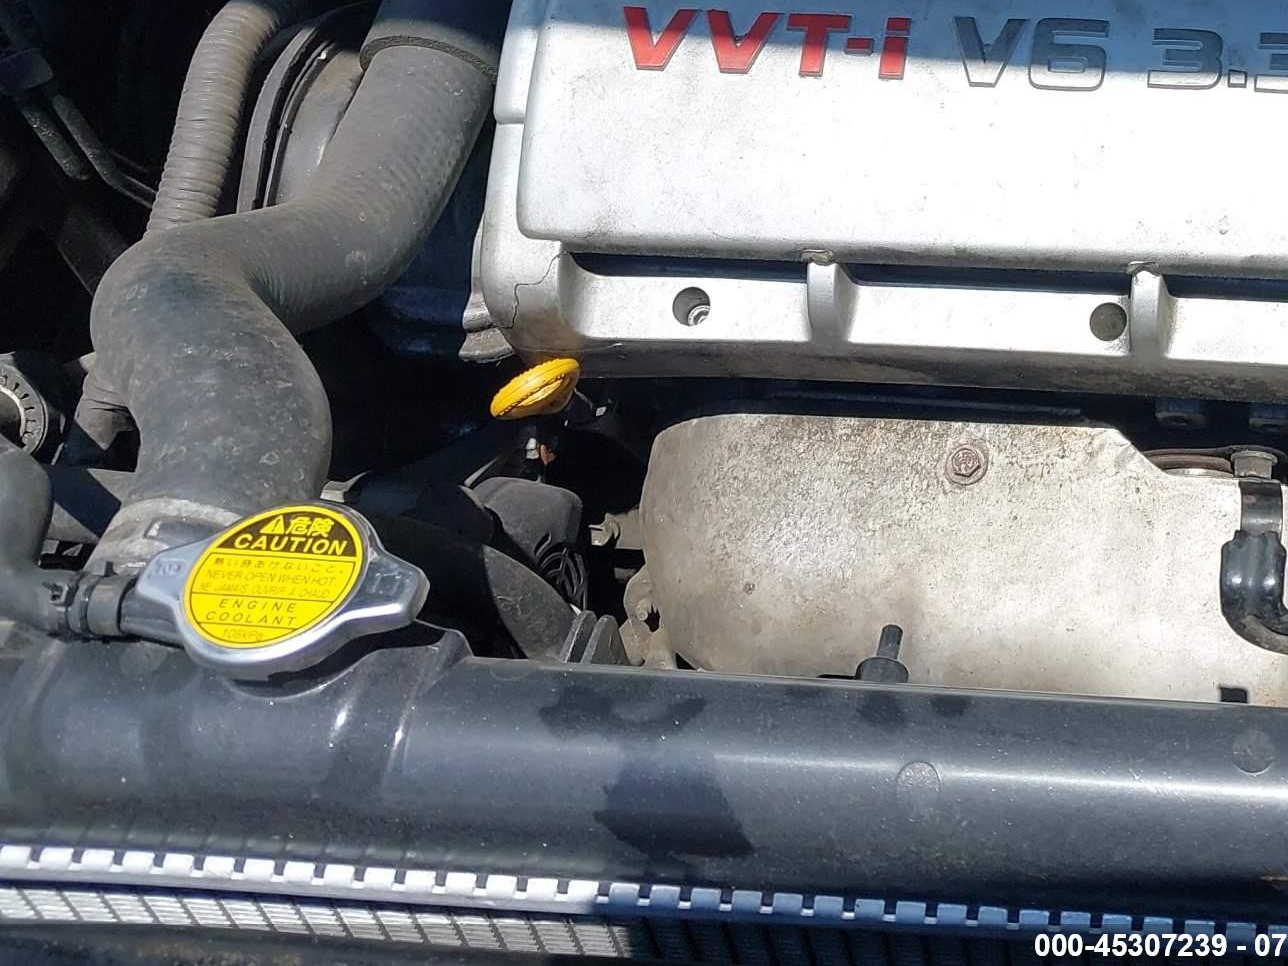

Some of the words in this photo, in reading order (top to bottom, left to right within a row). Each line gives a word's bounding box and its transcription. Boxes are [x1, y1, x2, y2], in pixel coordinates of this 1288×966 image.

[622, 5, 912, 80] VVT-i
[951, 16, 1110, 93] V6
[286, 515, 334, 538] 危険
[234, 533, 347, 556] CAUTION
[207, 569, 242, 580] NEVER
[244, 571, 277, 583] OPEN
[278, 574, 311, 586] WHEN
[219, 598, 297, 613] ENGINE
[205, 610, 297, 627] COOLANT
